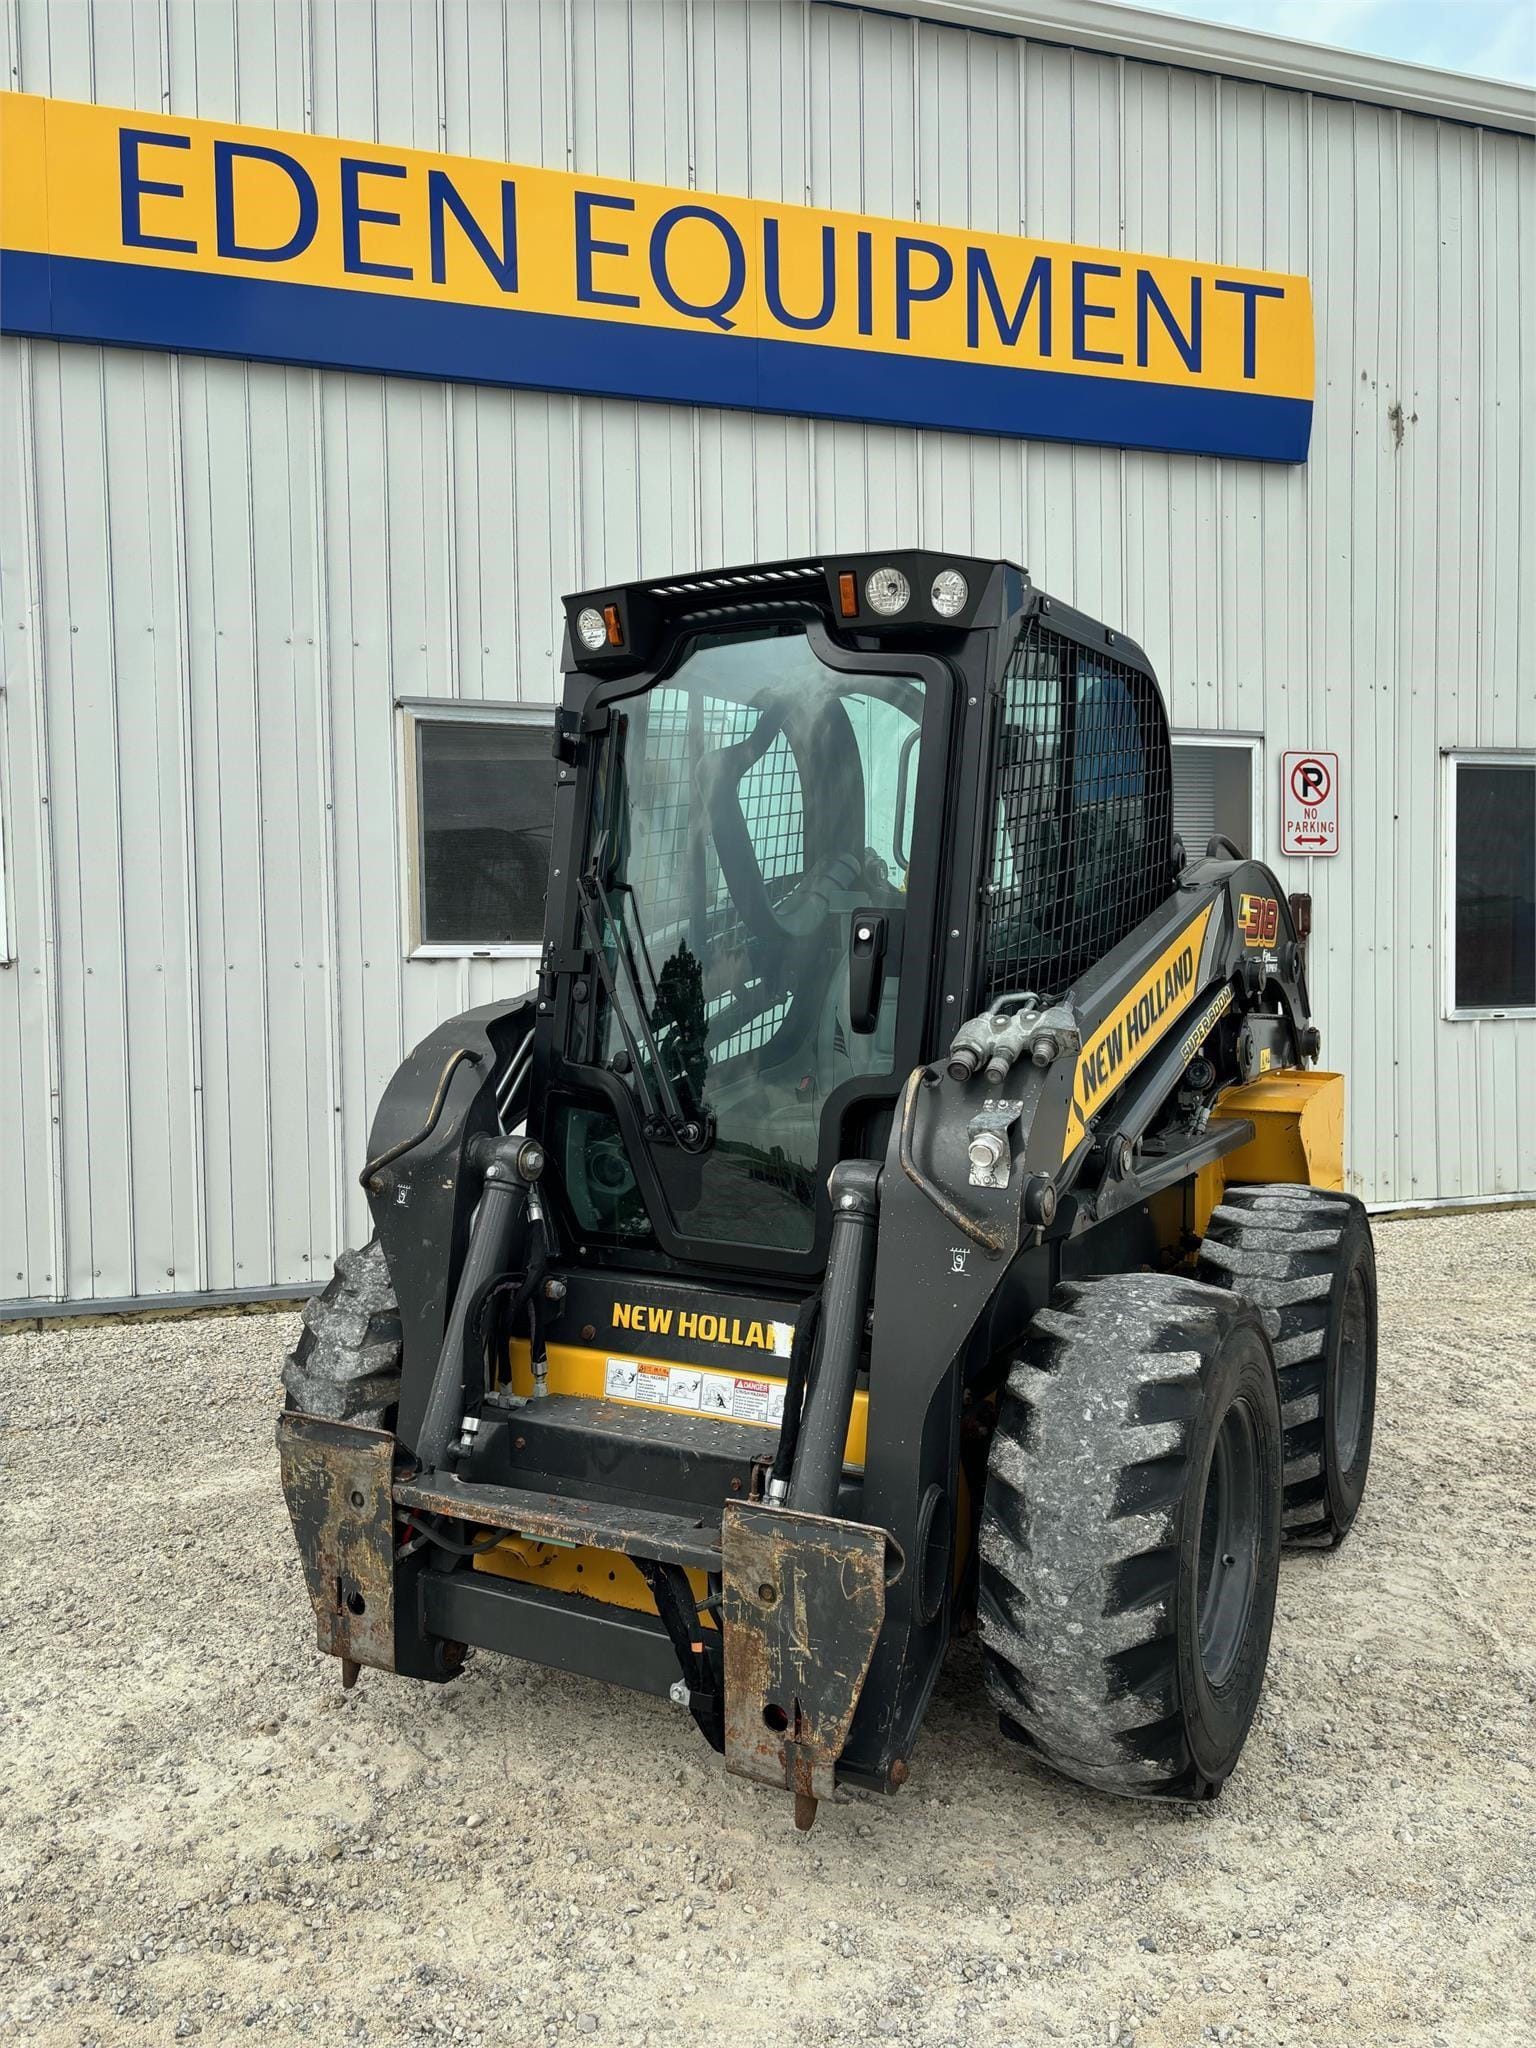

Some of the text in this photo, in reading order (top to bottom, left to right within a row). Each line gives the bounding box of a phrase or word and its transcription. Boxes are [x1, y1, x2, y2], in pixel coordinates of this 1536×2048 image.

[118, 126, 1286, 380] EDEN EQUIPMENT
[1302, 767, 1323, 797] P
[1287, 821, 1335, 833] PARKING
[1303, 807, 1318, 820] NO
[1238, 893, 1279, 948] L318
[1081, 946, 1194, 1103] NEW HOLLAND
[611, 1302, 795, 1352] NEW HOLLA
[743, 1380, 769, 1392] DANGER
